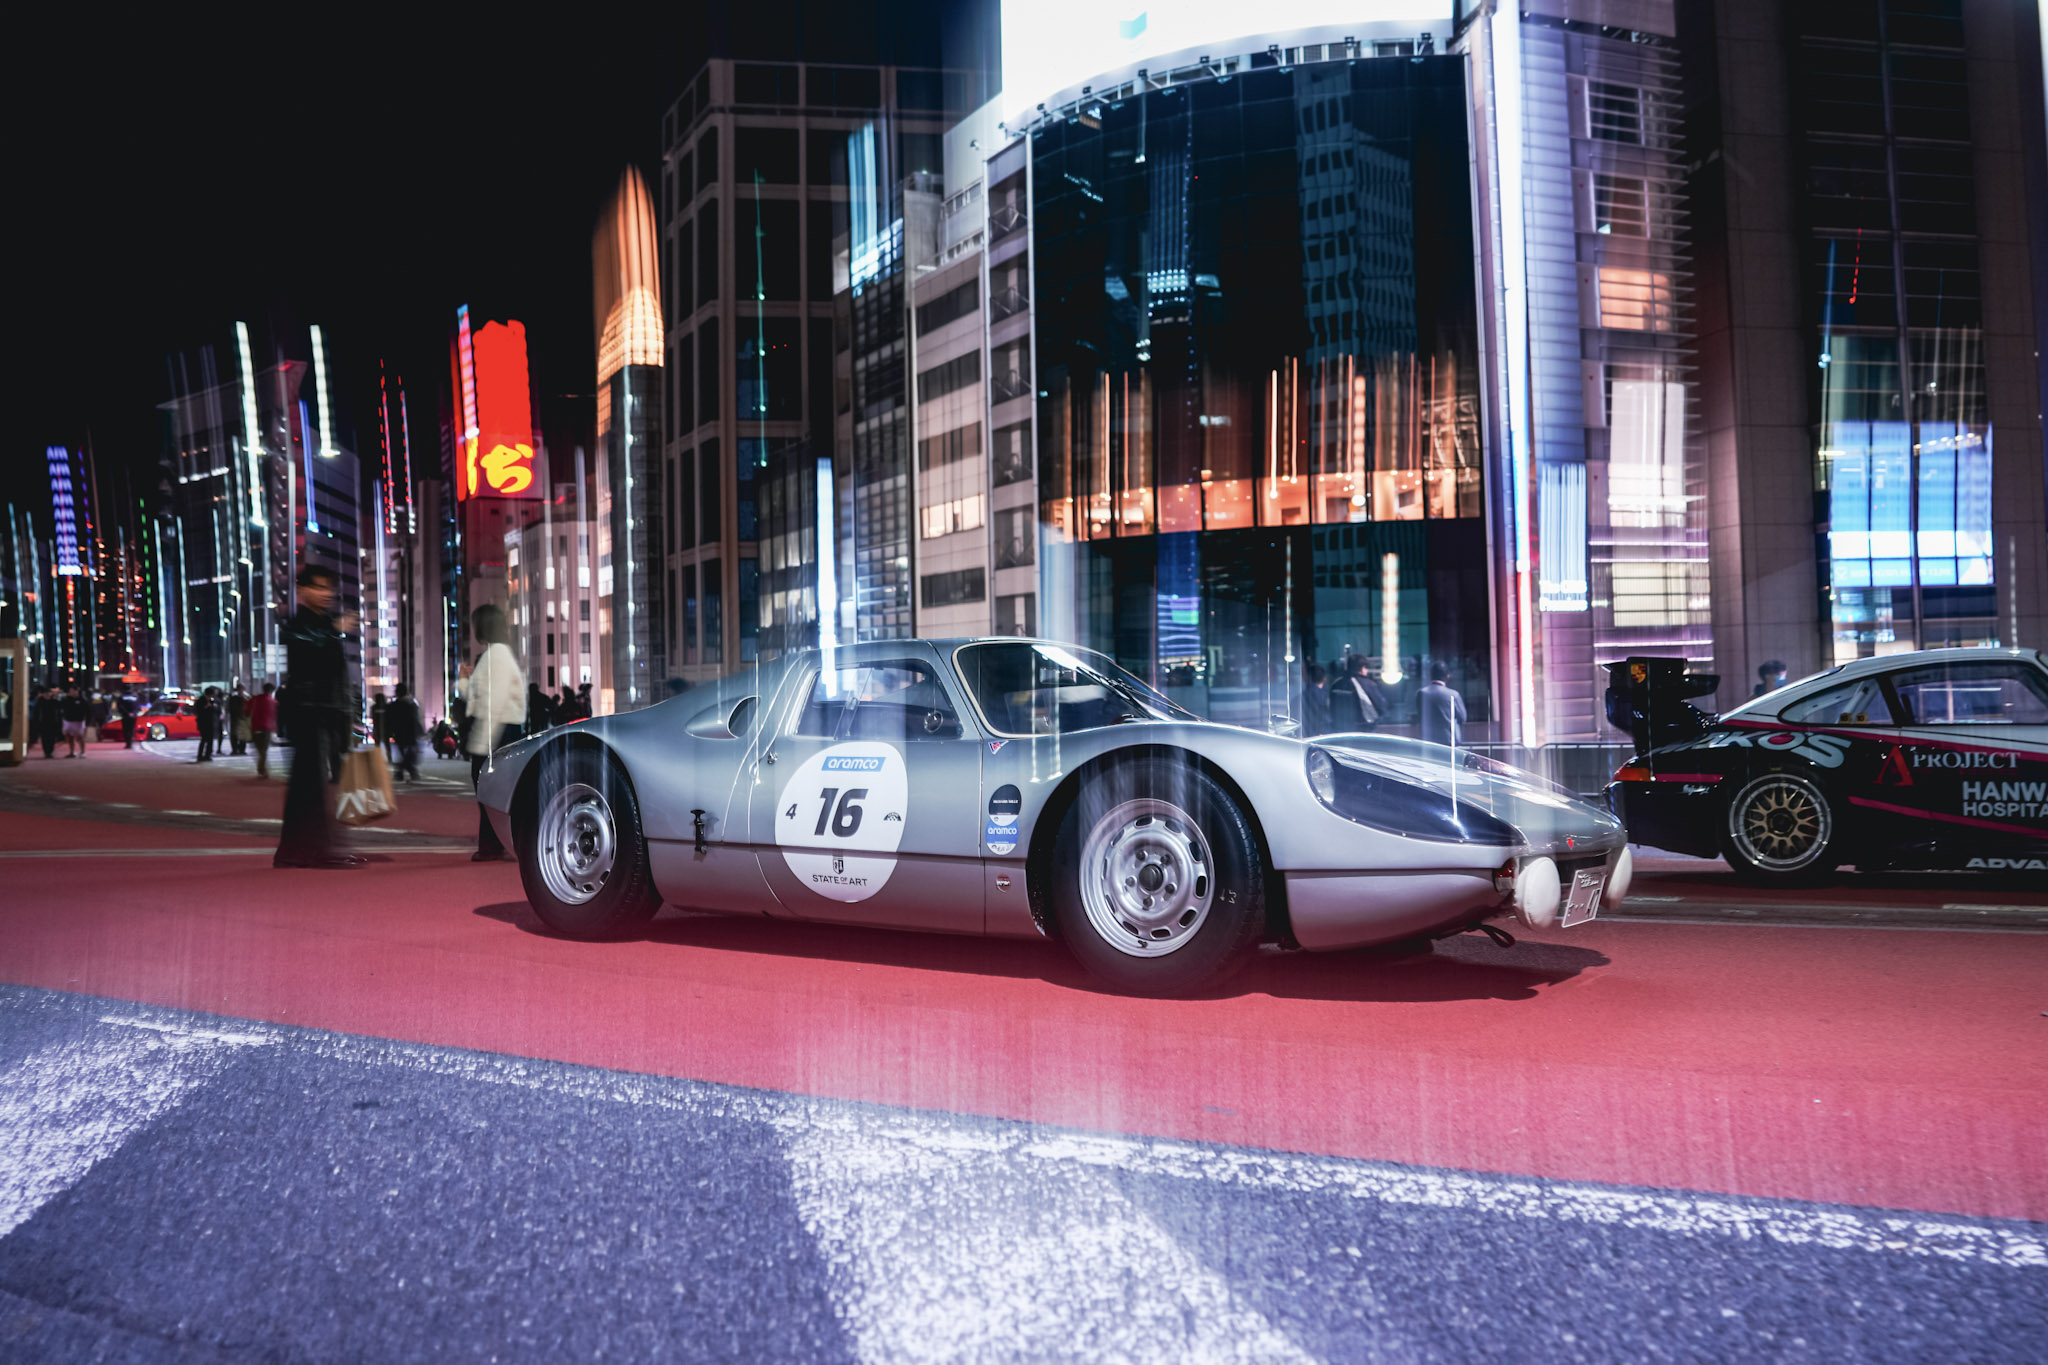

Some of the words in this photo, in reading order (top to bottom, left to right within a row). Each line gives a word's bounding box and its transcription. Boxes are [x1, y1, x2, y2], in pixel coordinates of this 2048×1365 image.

[827, 757, 879, 769] aramco
[1912, 751, 2021, 769] PROJECT
[1962, 781, 2048, 802] HANW
[785, 804, 798, 819] 4
[813, 788, 869, 838] 16
[987, 827, 1018, 835] aramco
[1965, 857, 2048, 870] ADVA
[812, 874, 840, 884] STATE
[849, 877, 868, 886] ART
